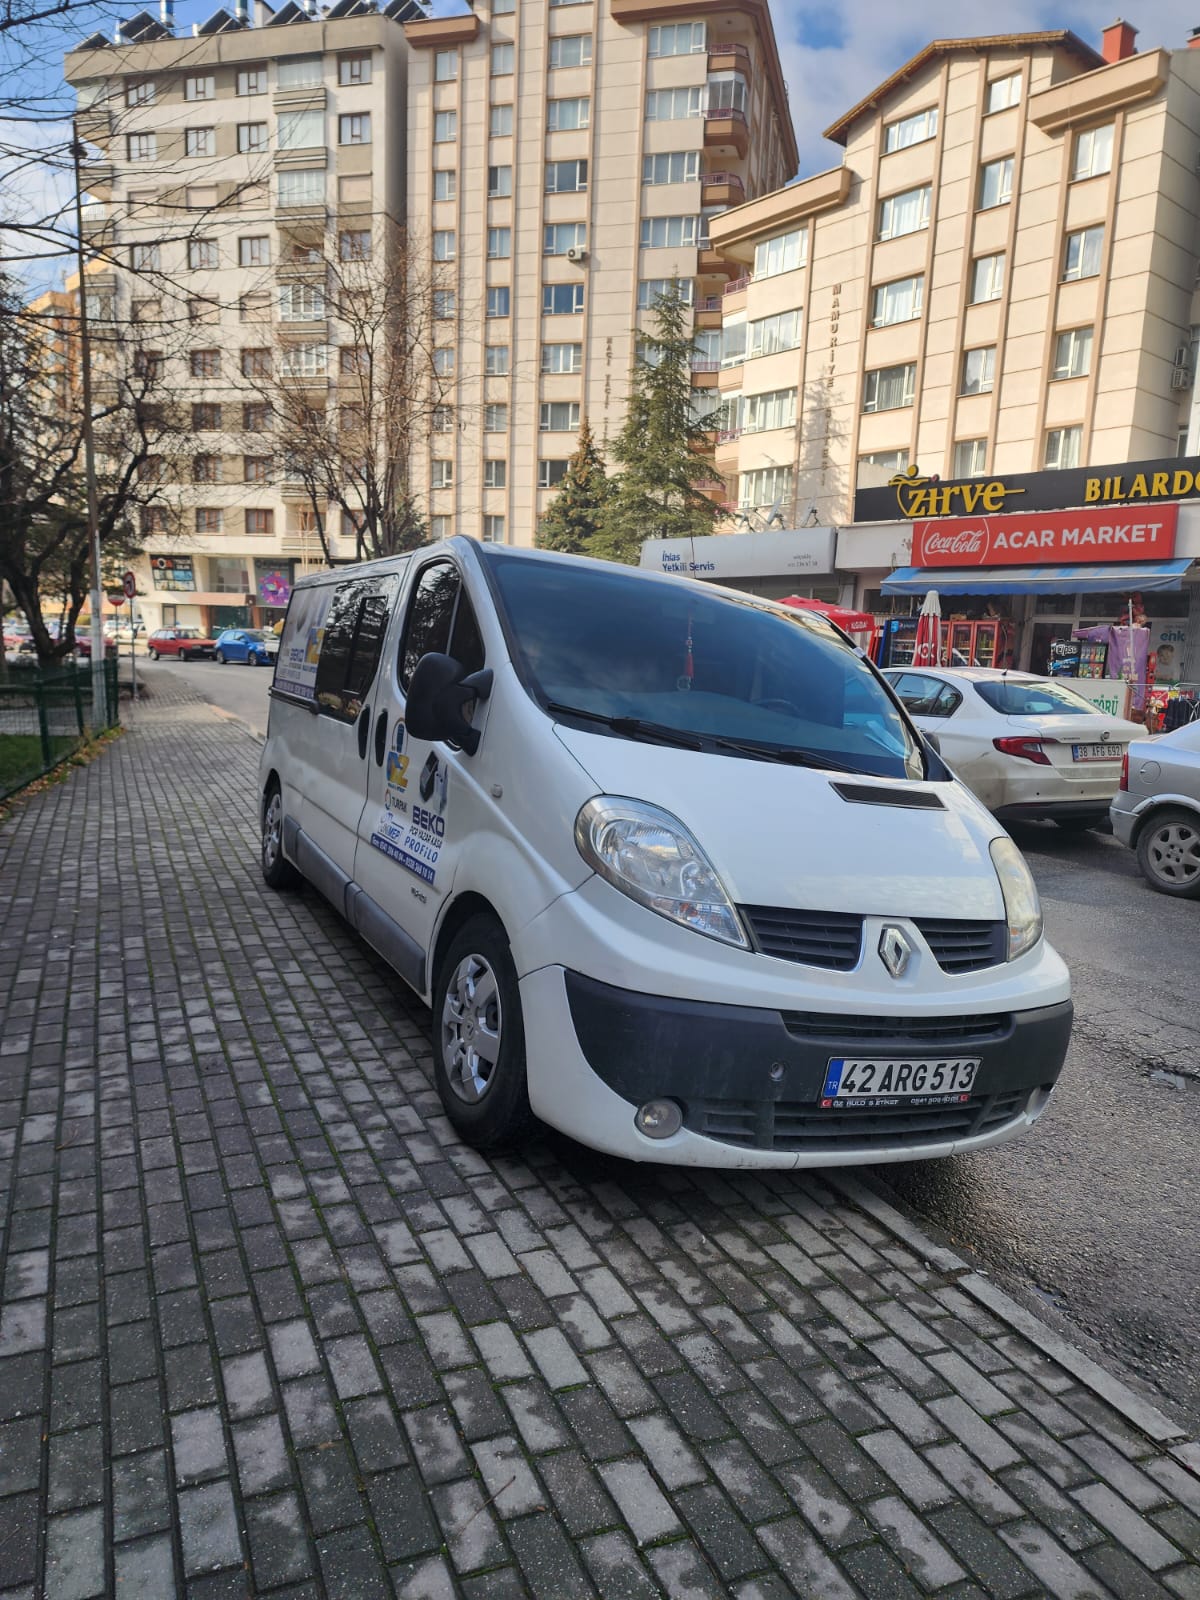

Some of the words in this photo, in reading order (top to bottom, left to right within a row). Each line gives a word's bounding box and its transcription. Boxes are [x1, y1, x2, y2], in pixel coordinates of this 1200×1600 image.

[924, 530, 985, 554] Coca-Cola
[993, 531, 1054, 550] ACAR
[1061, 523, 1163, 546] MARKET
[662, 550, 681, 562] İhlas
[662, 562, 688, 573] Yetkili
[689, 560, 716, 572] Servis
[1079, 746, 1088, 757] 38
[1092, 745, 1105, 757] AFG
[1107, 745, 1121, 756] 692
[412, 805, 446, 838] BEKO
[827, 1080, 838, 1090] TR
[841, 1063, 876, 1093] 42
[877, 1063, 928, 1093] ARG
[930, 1062, 976, 1090] 513
